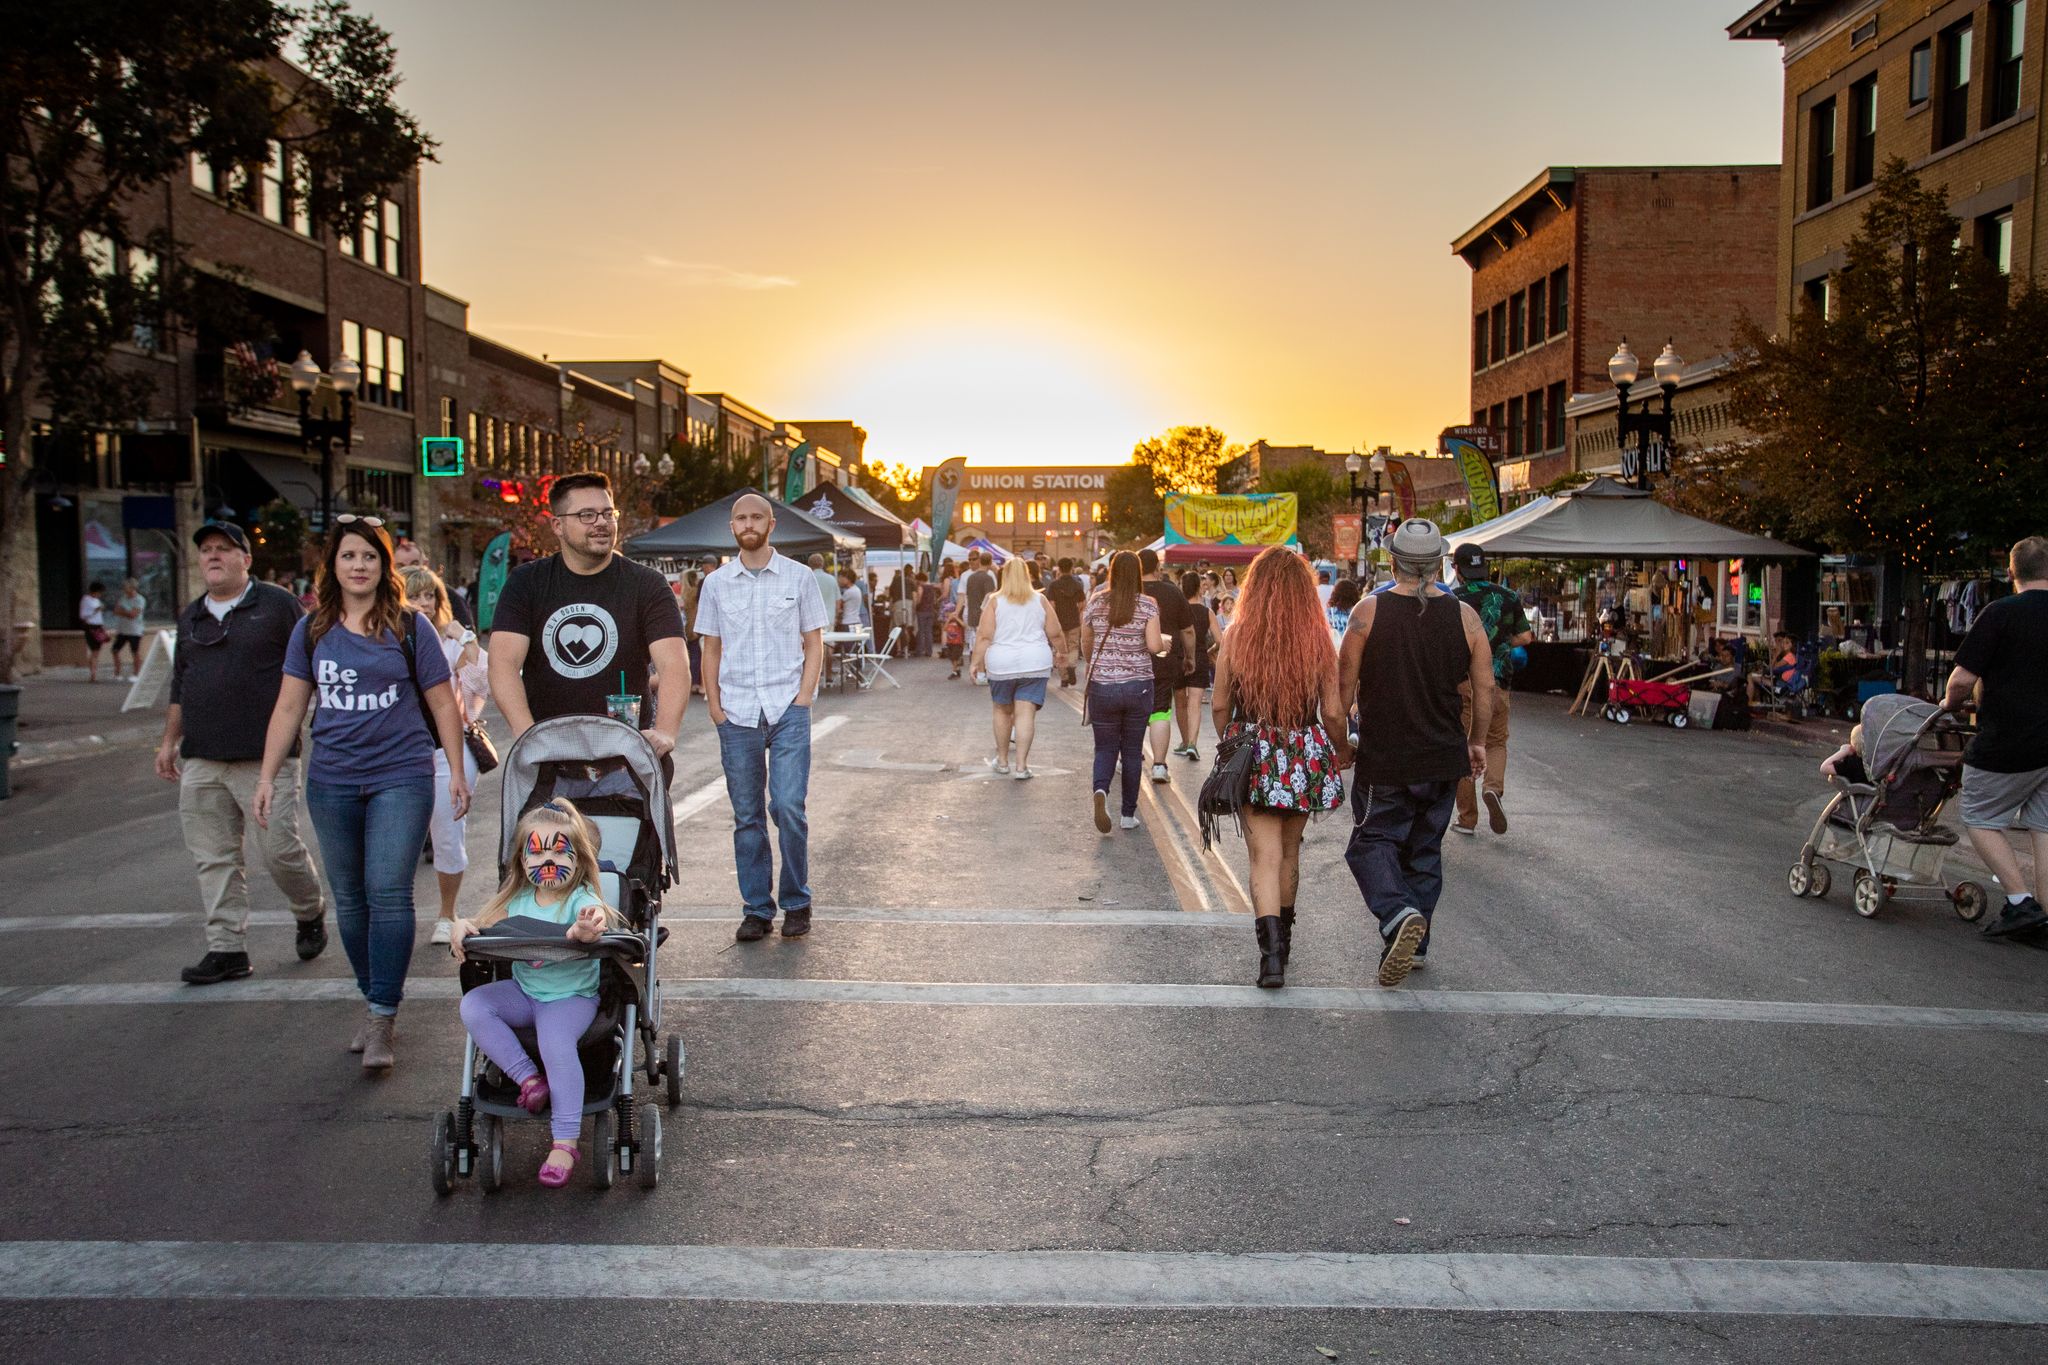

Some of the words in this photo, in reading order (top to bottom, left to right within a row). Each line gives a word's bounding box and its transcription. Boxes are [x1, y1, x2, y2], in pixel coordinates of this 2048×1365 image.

[1454, 427, 1488, 435] WINDSOR
[970, 474, 1025, 489] UNION
[1032, 474, 1105, 489] STATION
[1183, 501, 1288, 540] LEMONADE
[560, 605, 586, 616] OGDEN
[561, 667, 579, 677] LOCAL
[601, 631, 617, 664] VOLUNTEER
[318, 659, 358, 684] Be
[318, 683, 400, 711] Kind
